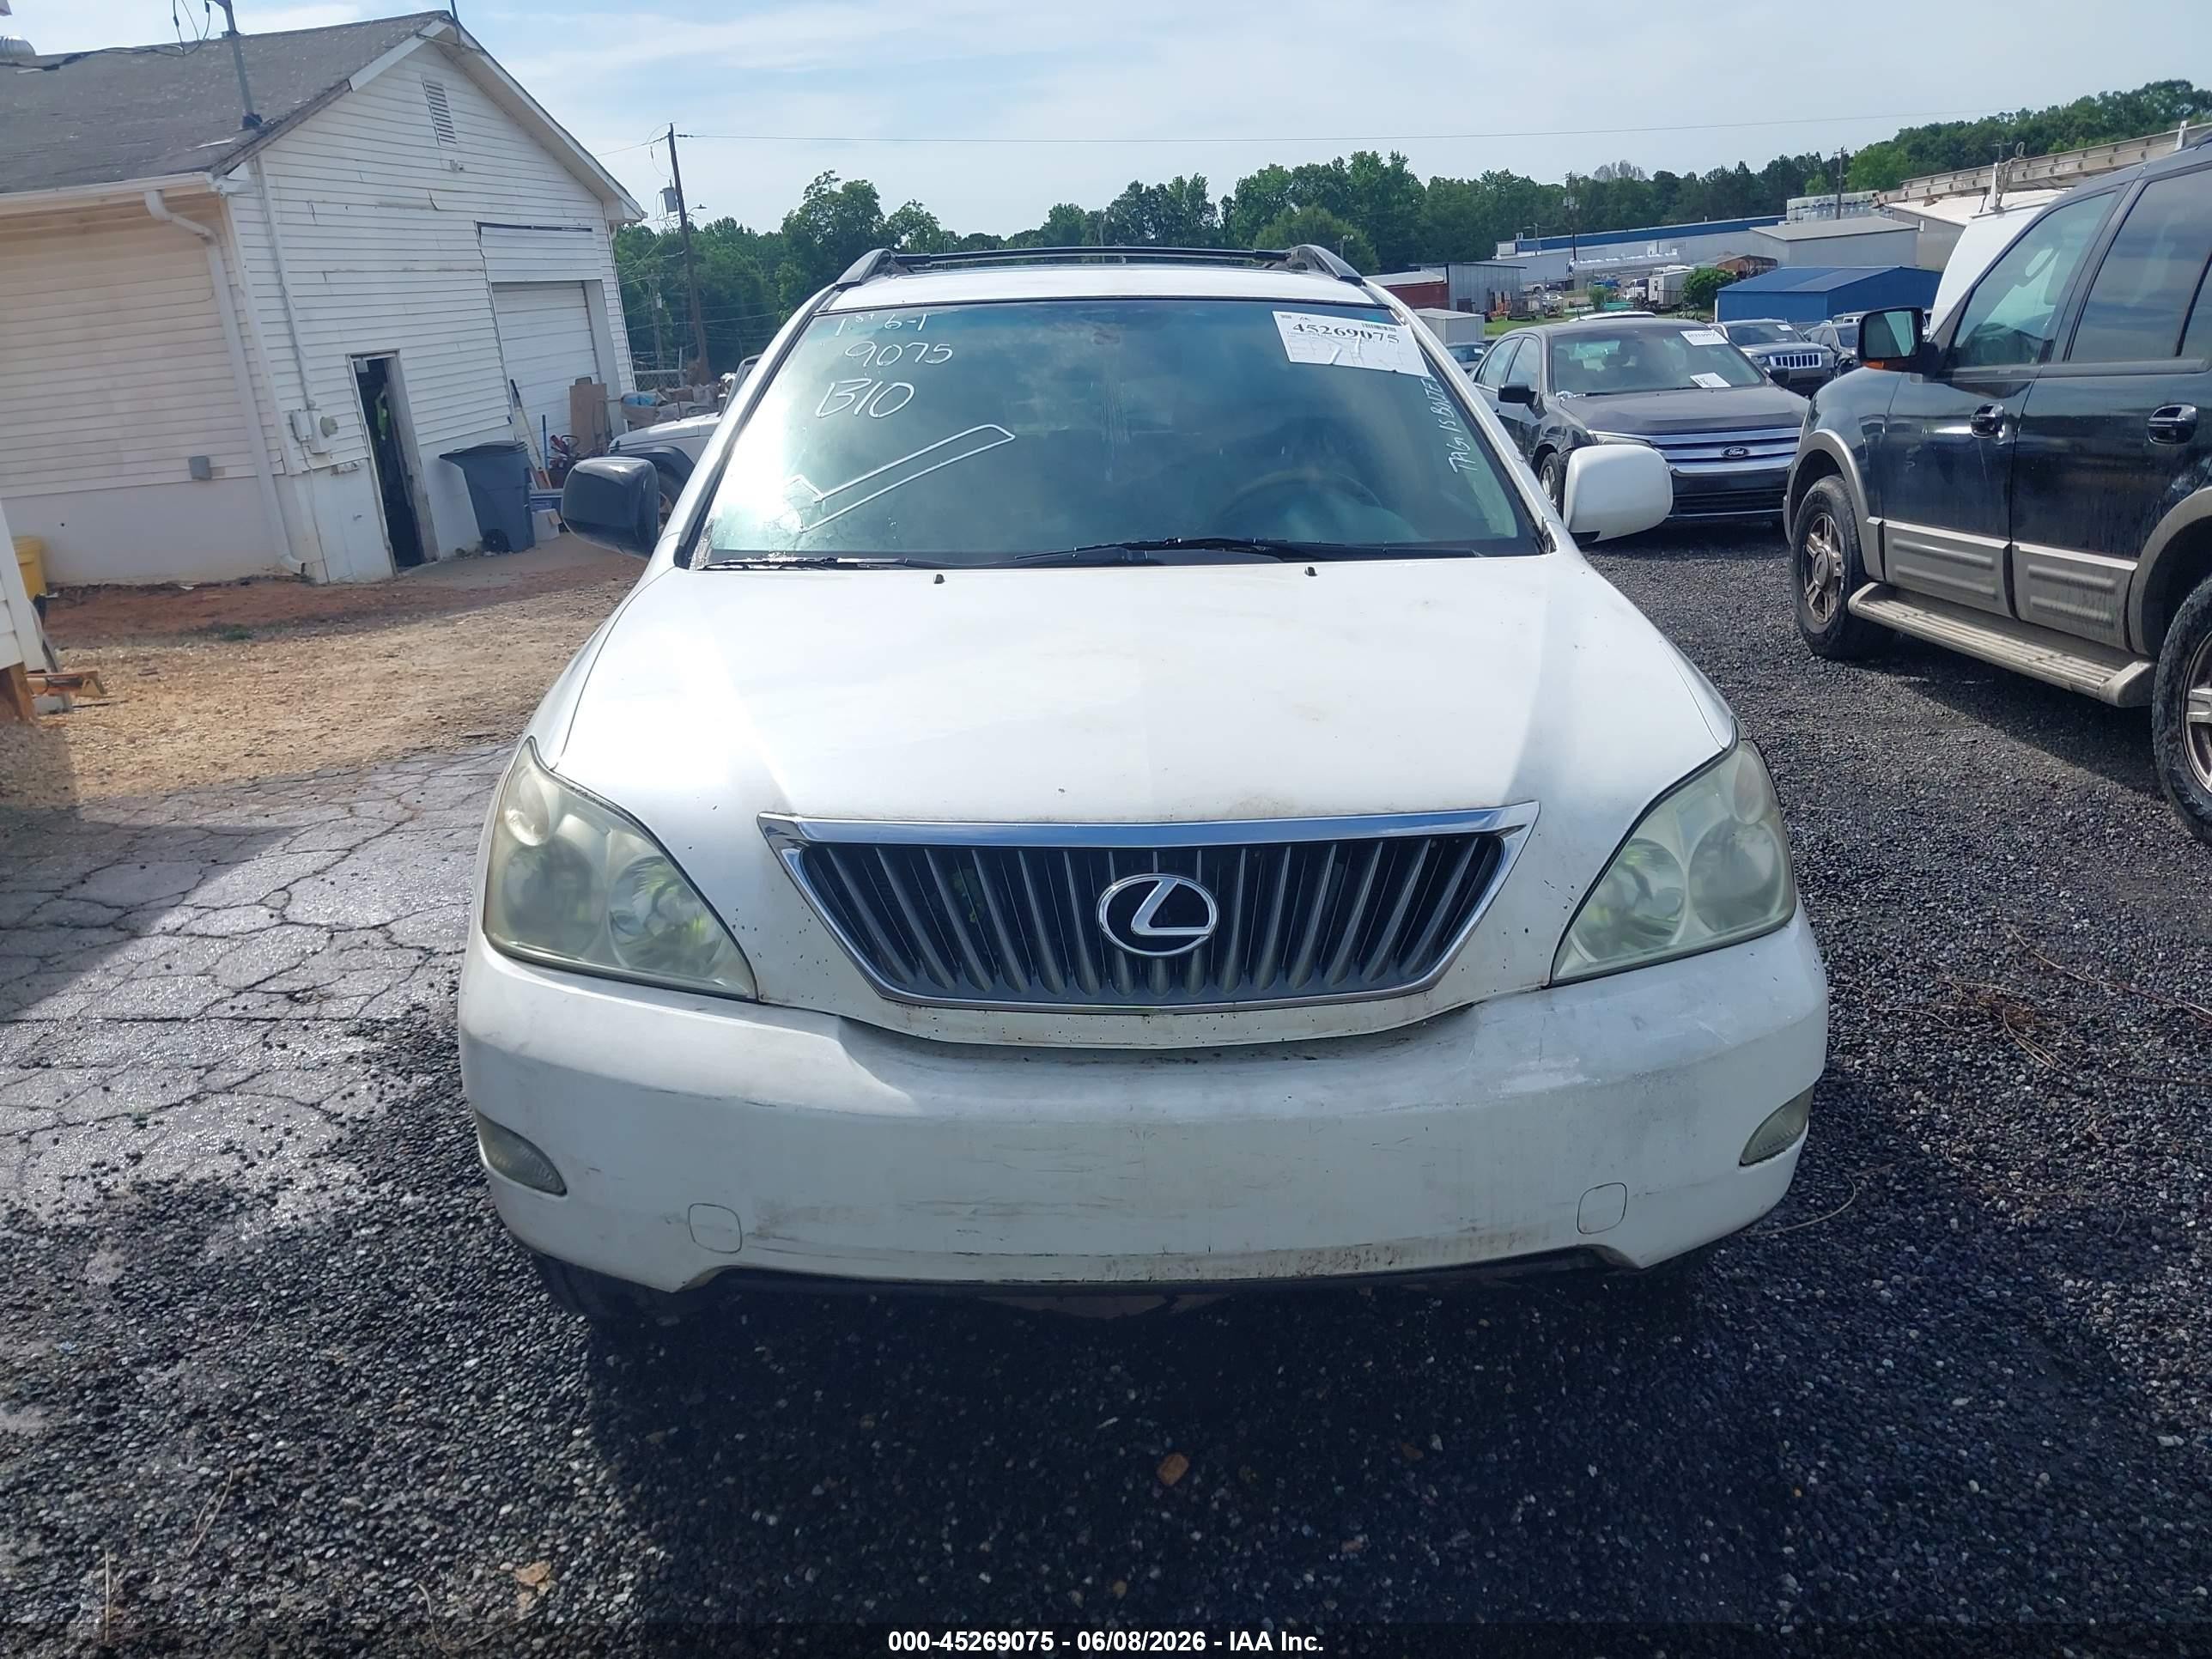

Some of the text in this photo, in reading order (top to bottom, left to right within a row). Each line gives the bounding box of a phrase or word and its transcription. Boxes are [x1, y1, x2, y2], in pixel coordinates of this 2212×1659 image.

[1292, 322, 1400, 343] 45269075
[845, 341, 954, 367] 9075
[1438, 418, 1462, 434] IS
[1445, 436, 1478, 473] TAG
